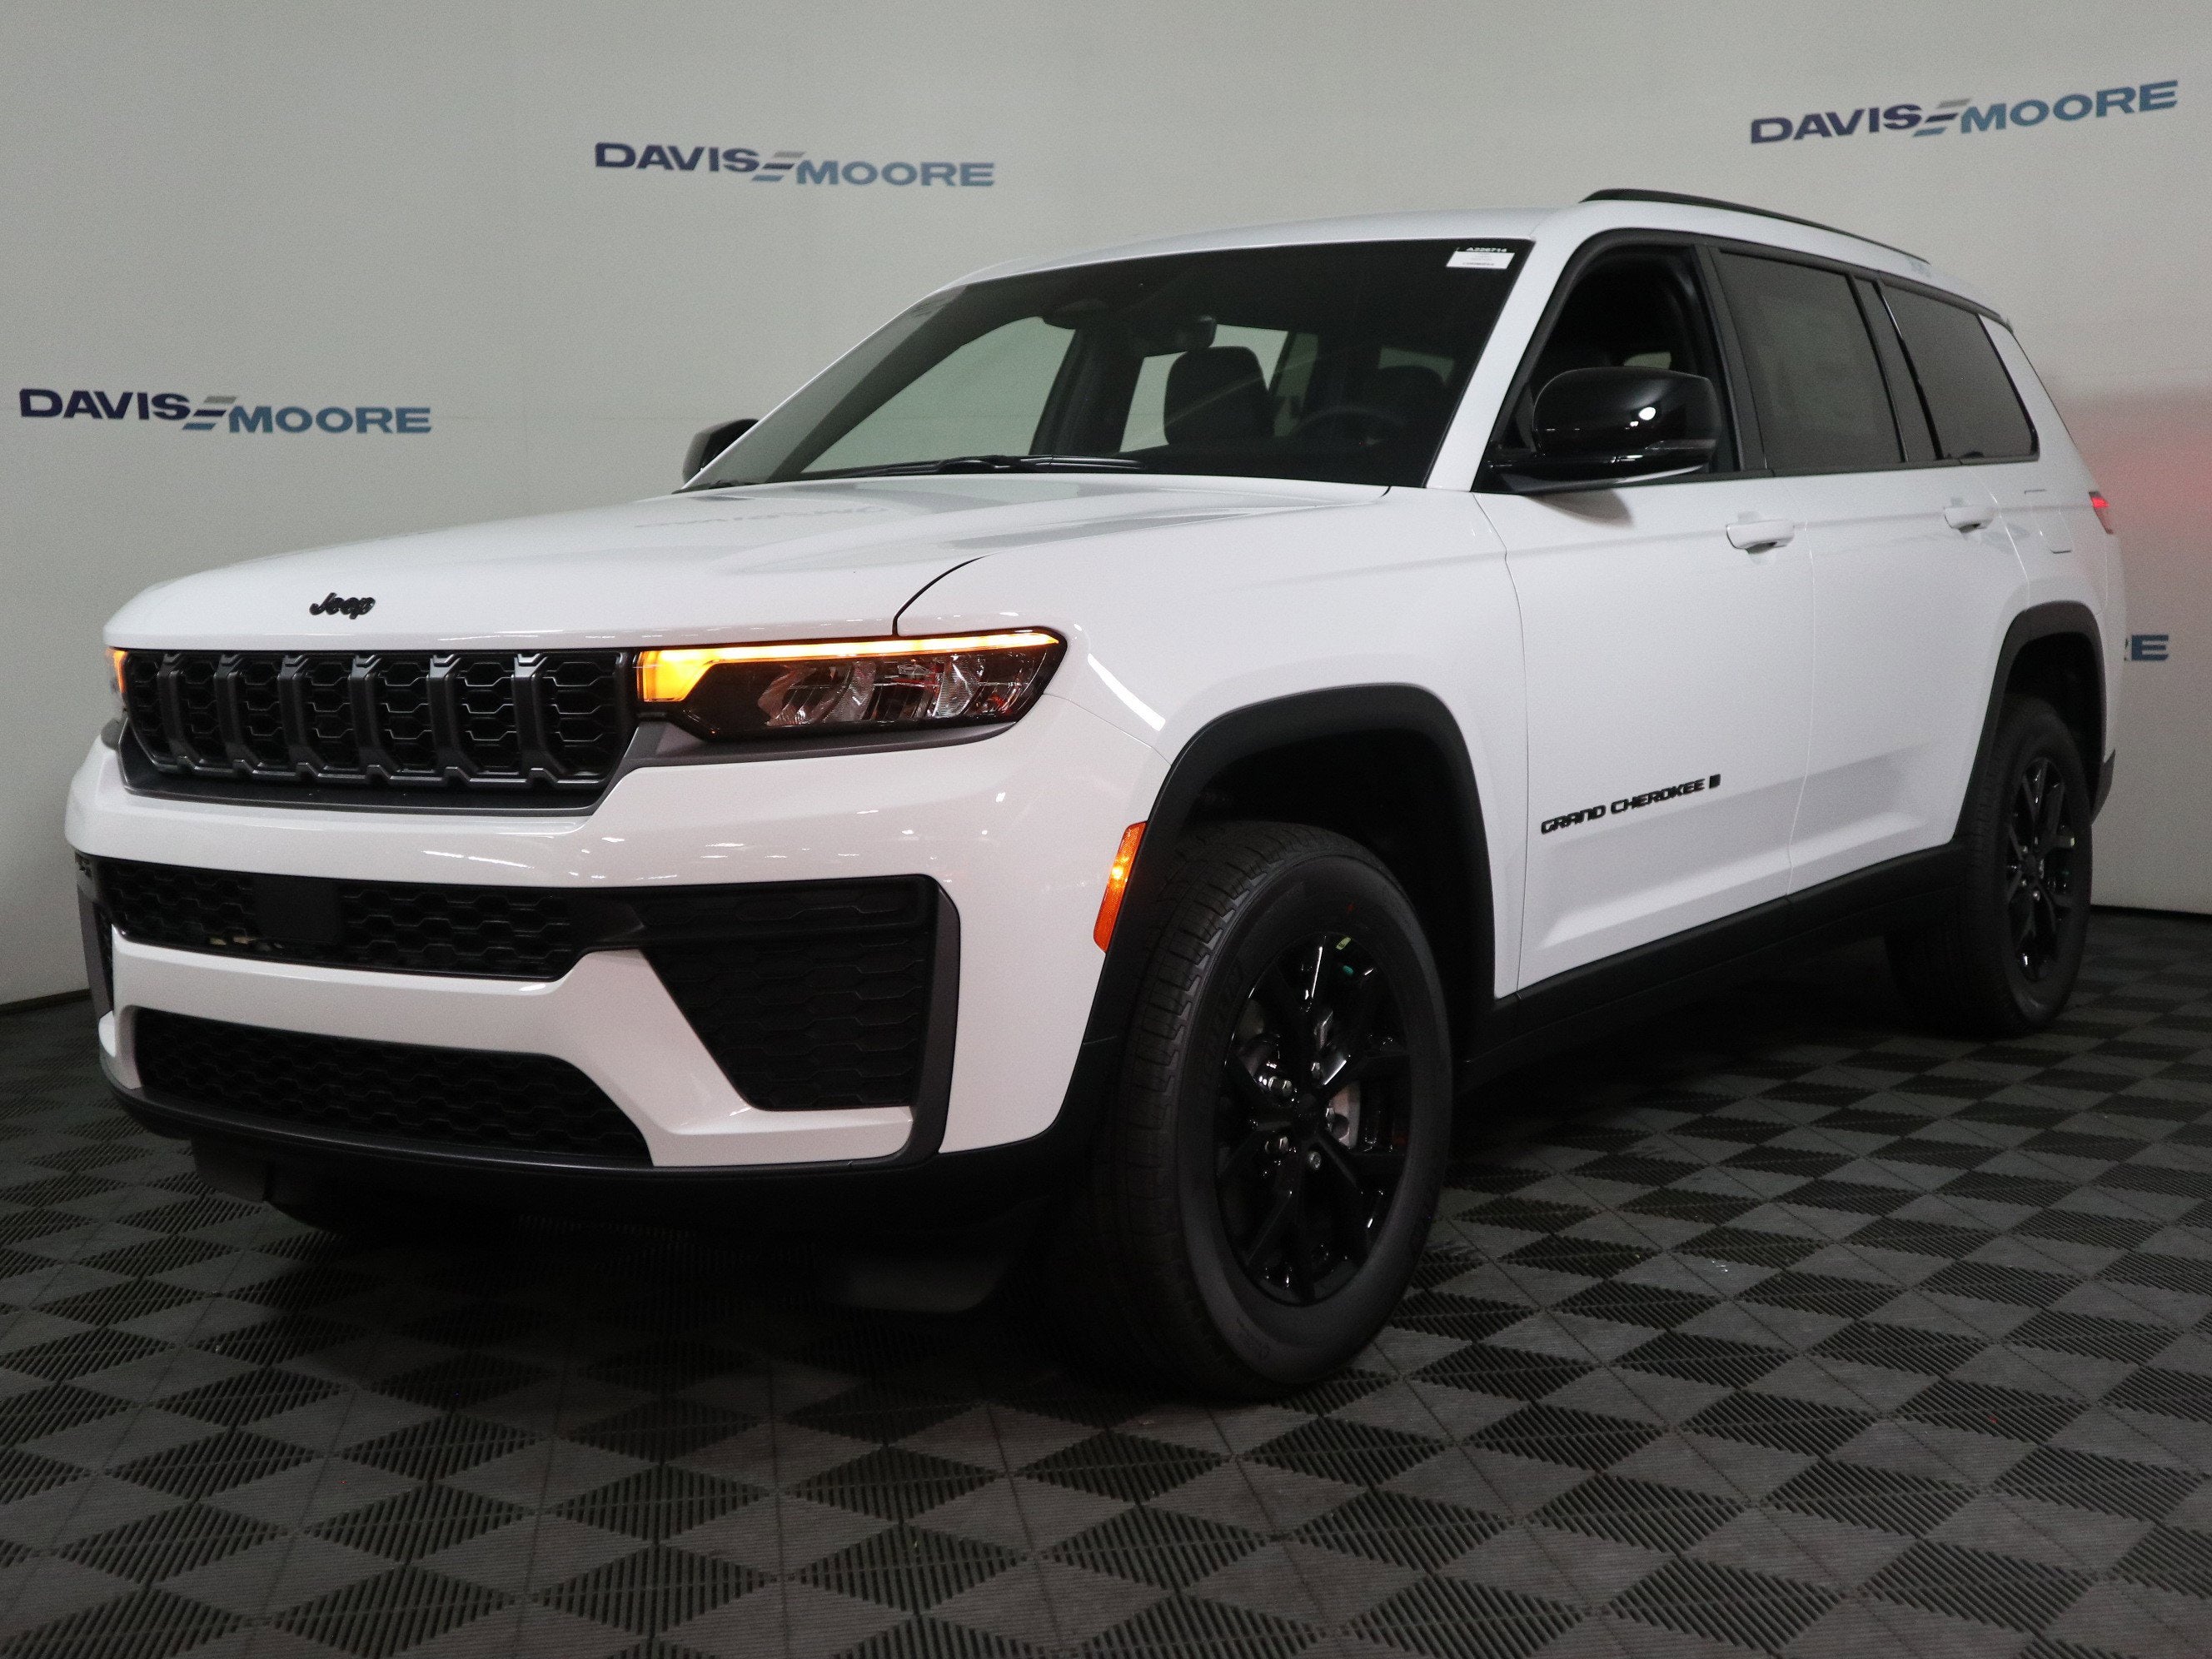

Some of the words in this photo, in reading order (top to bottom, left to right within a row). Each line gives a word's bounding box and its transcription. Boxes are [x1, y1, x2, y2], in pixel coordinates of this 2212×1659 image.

[1750, 103, 1922, 144] DAVIS
[1960, 80, 2178, 134] MOORE
[594, 142, 760, 172] DAVIS
[796, 160, 994, 187] MOORE
[19, 388, 190, 420] DAVIS
[229, 405, 431, 433] MOORE
[309, 592, 376, 620] Jeep
[1541, 805, 1607, 834] GRAND
[1611, 778, 1706, 815] CHEROKEE
